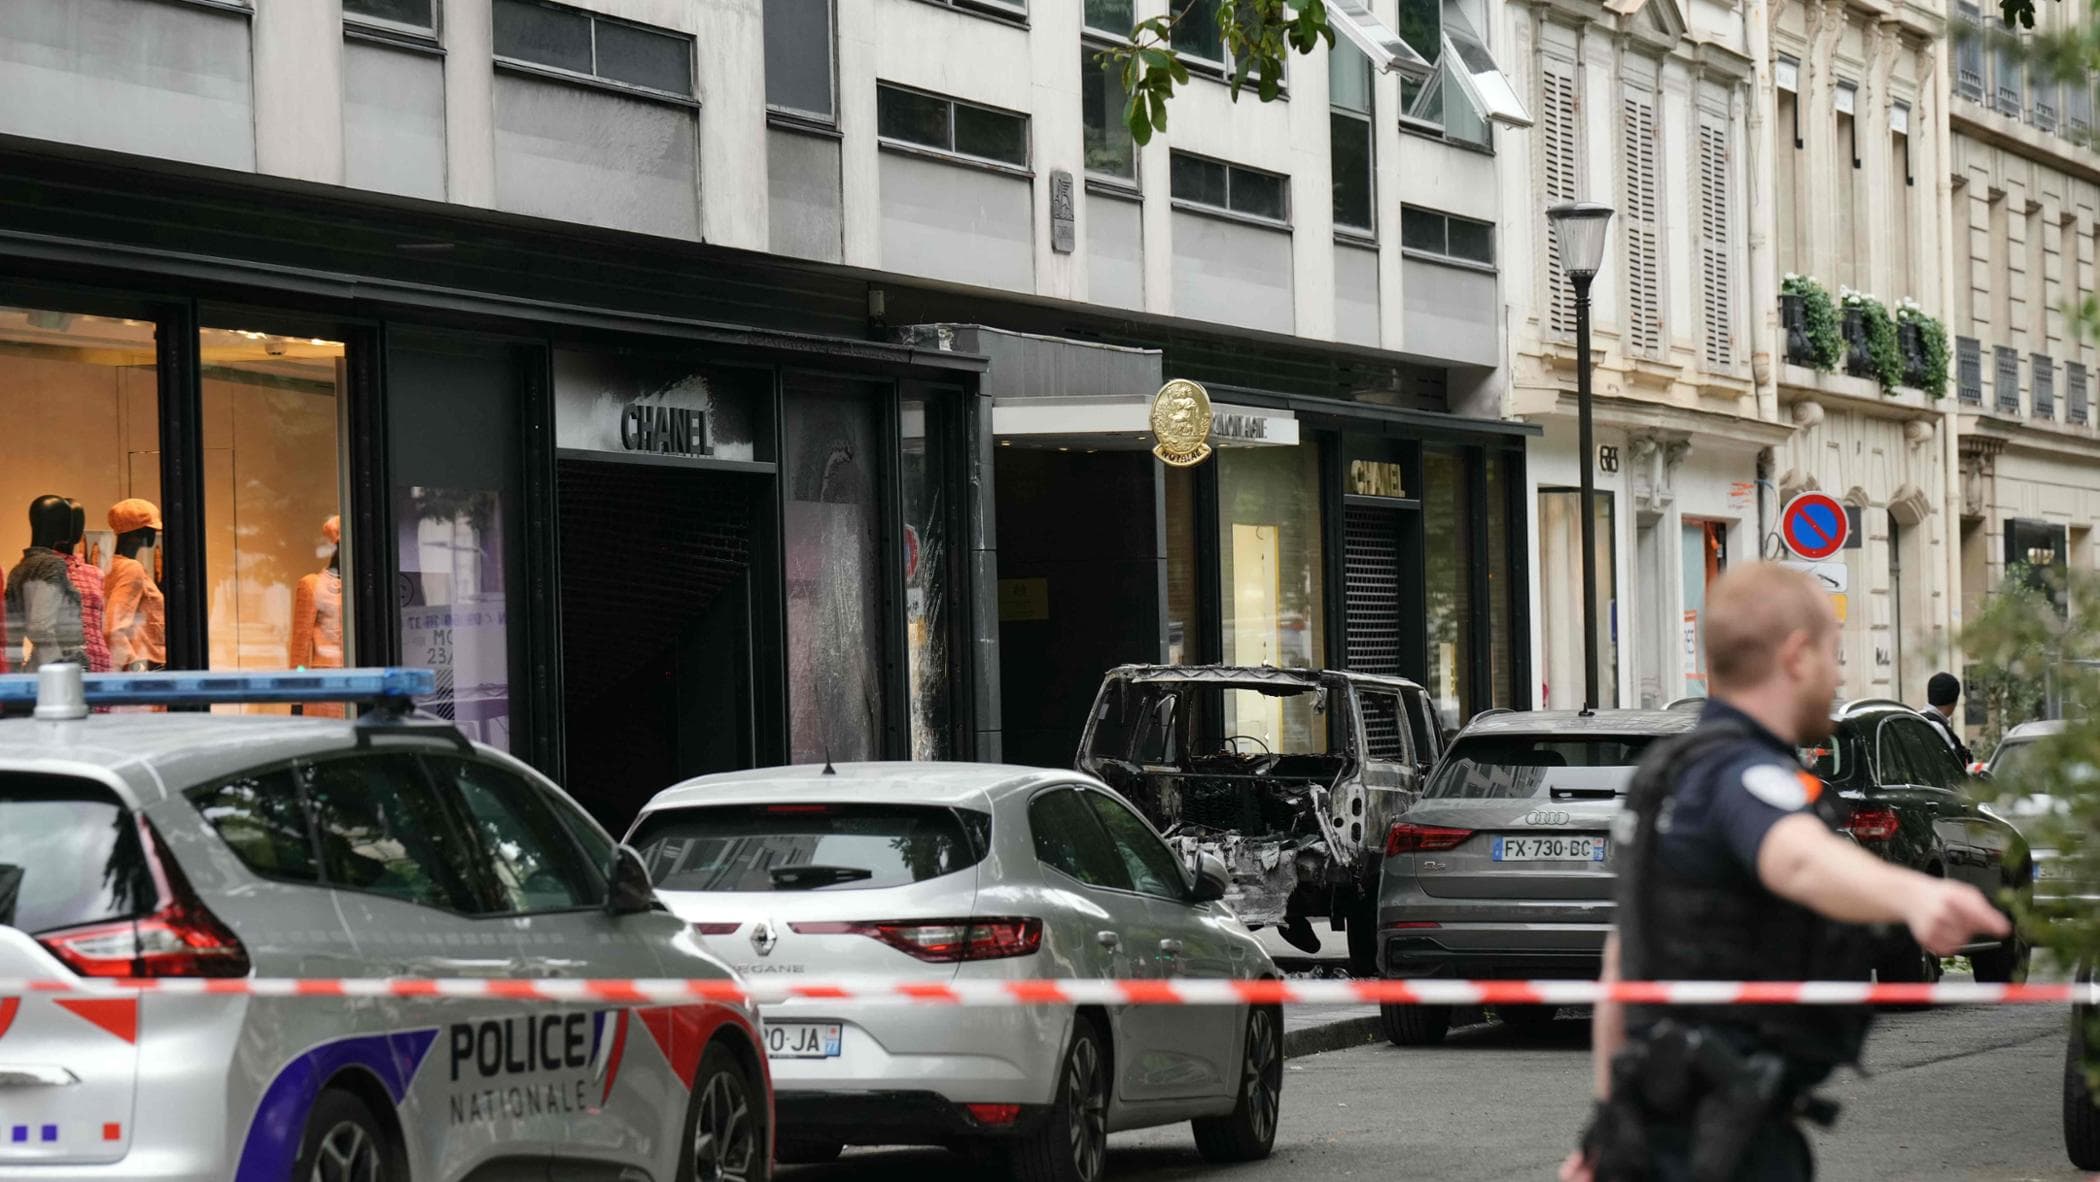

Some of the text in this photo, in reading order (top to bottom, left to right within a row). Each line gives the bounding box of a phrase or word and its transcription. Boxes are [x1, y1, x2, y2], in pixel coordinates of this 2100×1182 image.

[621, 403, 714, 455] CHANEL
[1350, 459, 1406, 498] CHANEL
[451, 1013, 587, 1082] POLICE
[451, 1080, 586, 1126] NATIONALE
